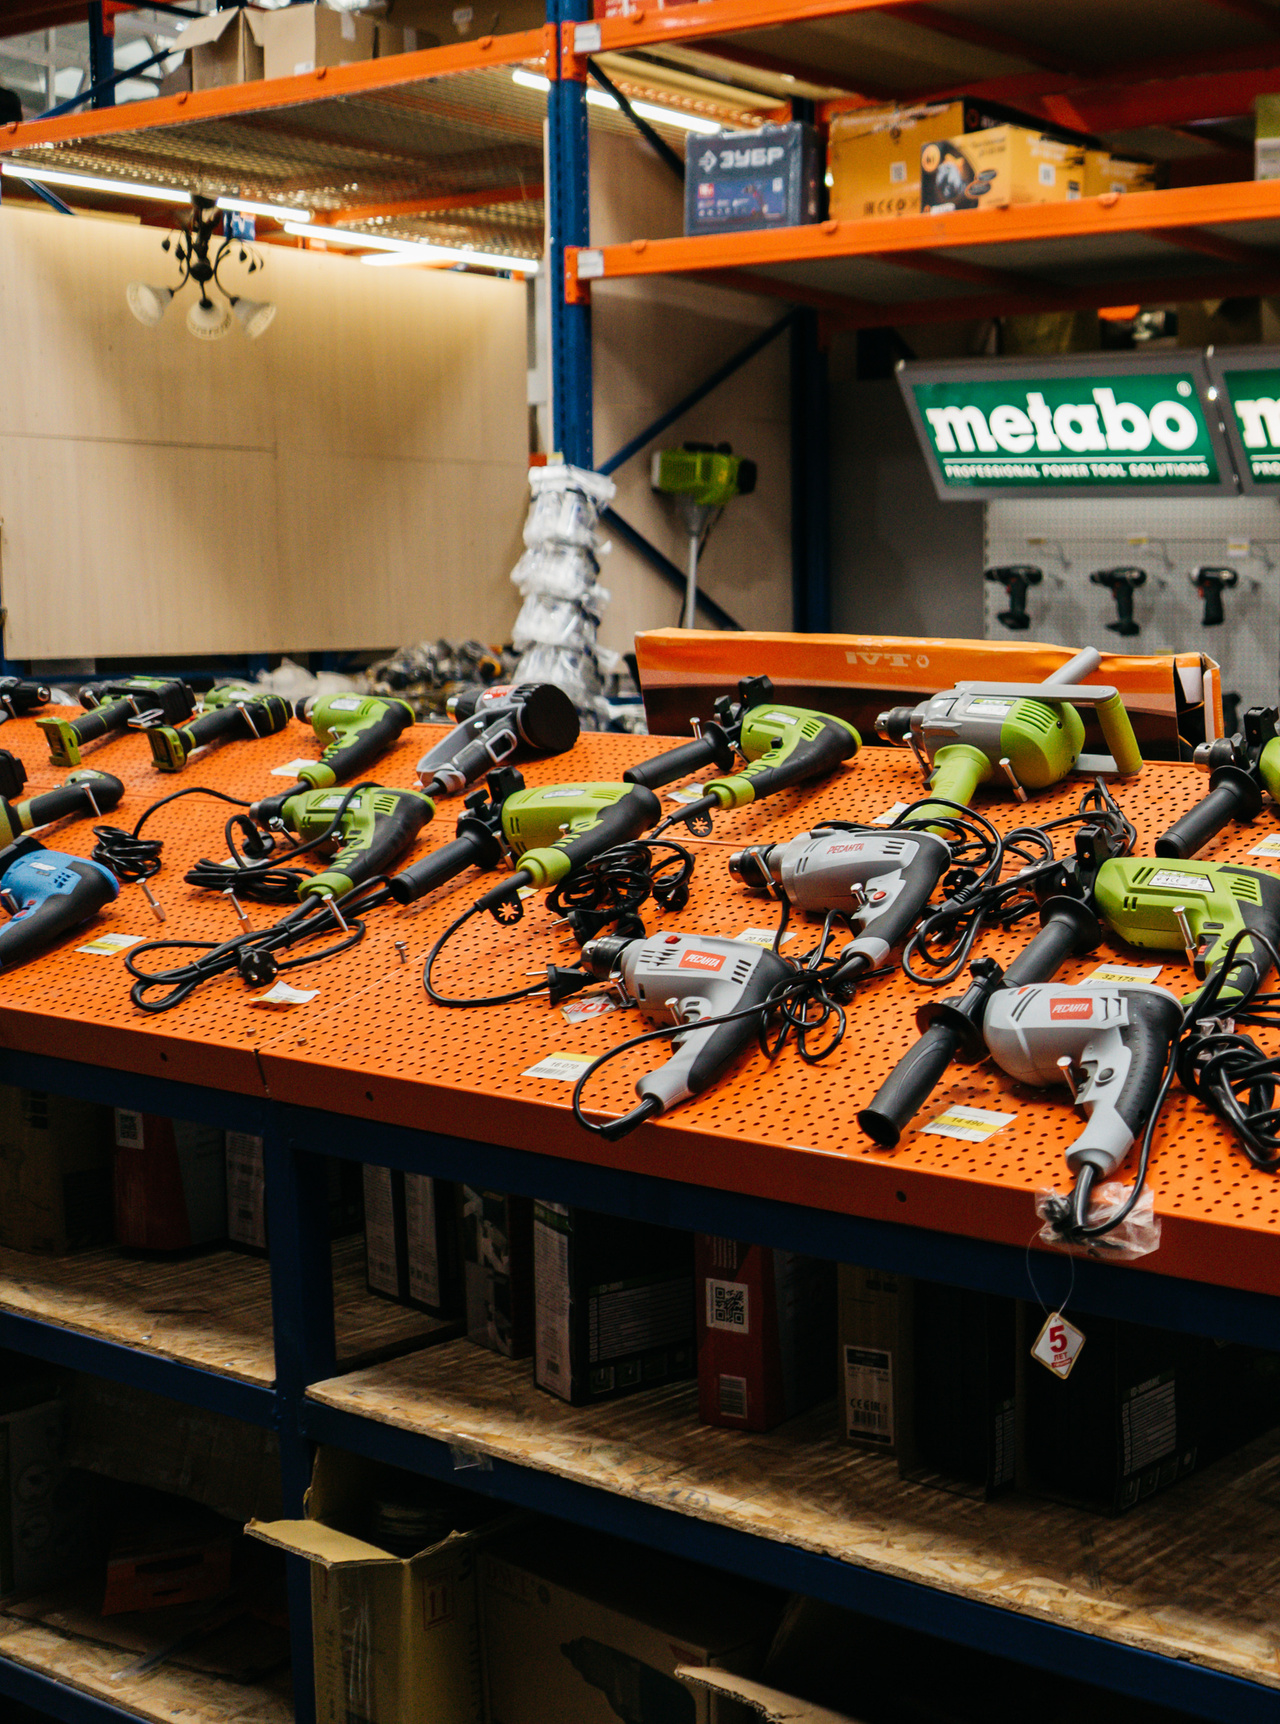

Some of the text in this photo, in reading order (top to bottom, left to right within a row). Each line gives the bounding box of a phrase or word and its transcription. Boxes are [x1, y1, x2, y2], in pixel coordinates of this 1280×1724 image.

[720, 146, 784, 169] ЗУБР
[925, 387, 1199, 453] metabo
[945, 462, 1210, 478] PROFESSIONAL POWER TOOL SOLUTIONS
[845, 651, 911, 667] IVT
[826, 843, 865, 854] РЕСАНТА
[685, 953, 721, 967] РЕСАНТА
[1051, 1003, 1090, 1014] РЕСАНТА
[1049, 1324, 1068, 1353] 5
[1053, 1352, 1068, 1361] ЛЕТ
